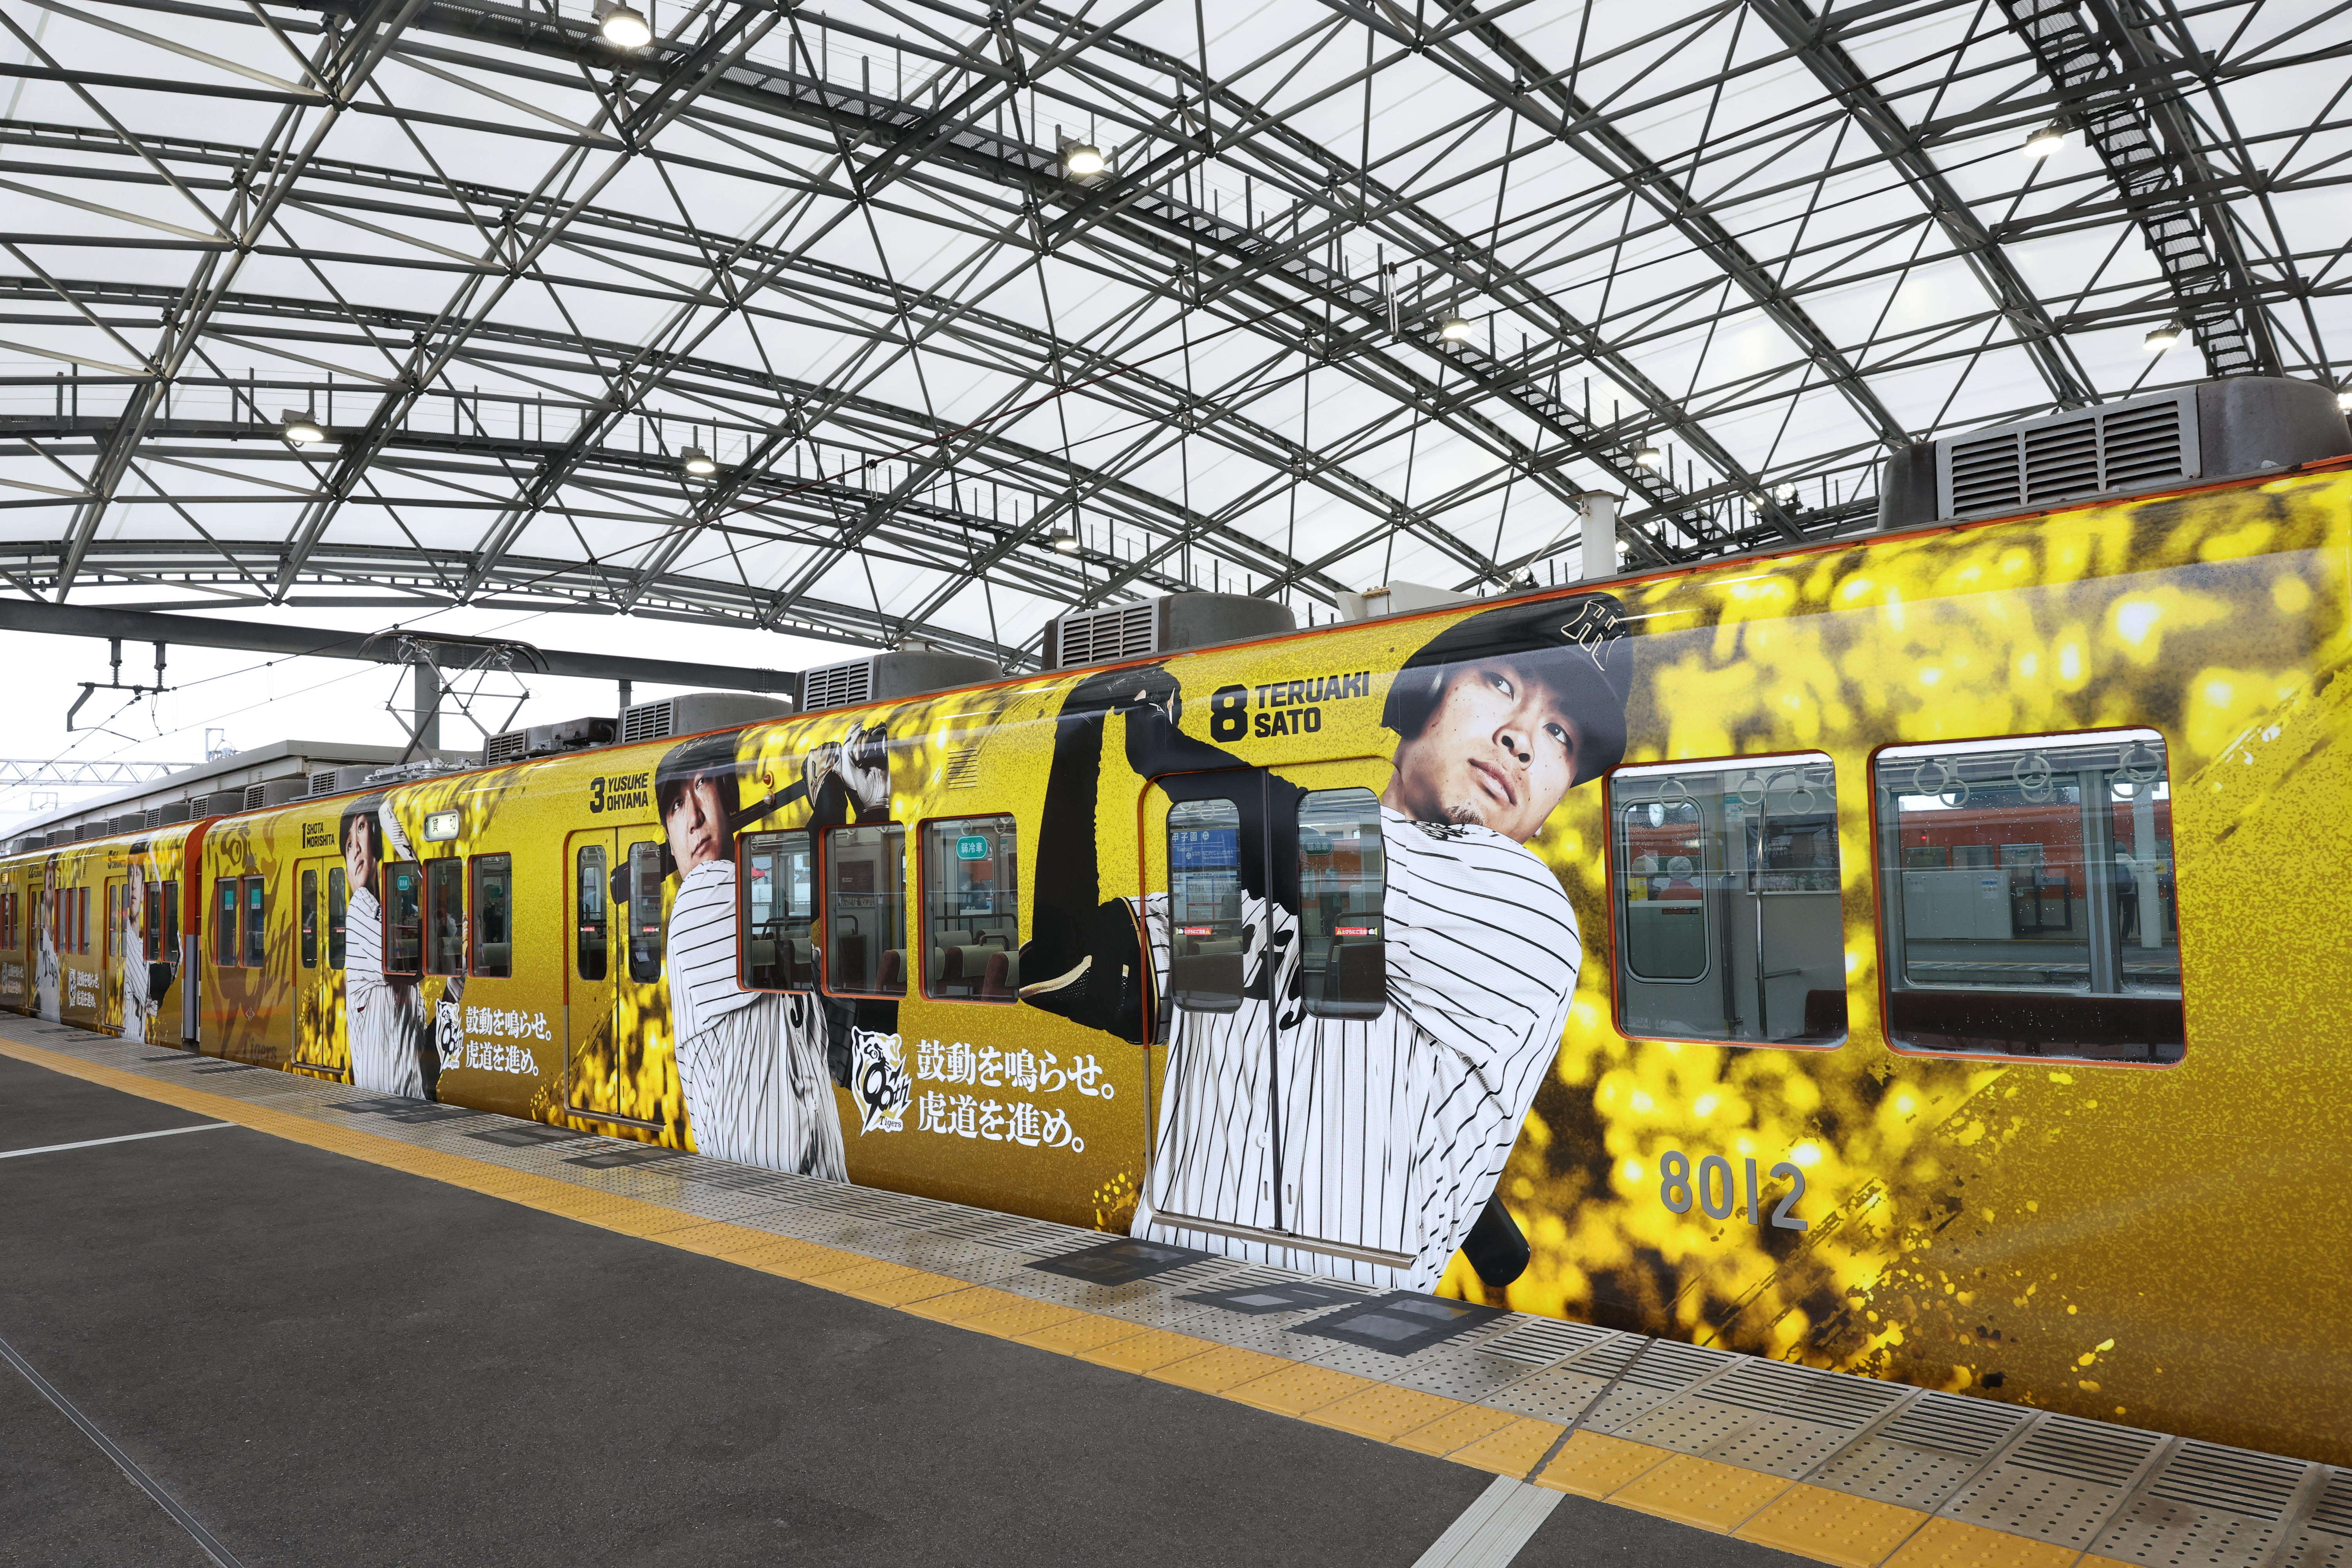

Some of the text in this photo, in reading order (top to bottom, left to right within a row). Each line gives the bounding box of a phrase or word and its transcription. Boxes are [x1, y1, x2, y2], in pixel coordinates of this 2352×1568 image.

[1255, 671, 1369, 710] TERUAKI
[1210, 684, 1248, 743] 8
[1254, 707, 1321, 738] SATO
[590, 777, 605, 813] 3
[608, 772, 650, 793] YUSUKE
[607, 791, 649, 811] OHYAMA
[302, 823, 307, 849] 1
[307, 822, 324, 835] SHOTA
[307, 834, 335, 848] MORISHITA
[1172, 831, 1198, 842] 甲子園
[961, 842, 983, 853] 弱冷車
[465, 1006, 551, 1041] 鼓動を鳴らせ。
[465, 1040, 539, 1076] 虎道を進め。
[916, 1039, 1114, 1100] 鼓動を鳴らせ。
[880, 1115, 901, 1129] Tigers
[917, 1090, 1085, 1153] 虎道を進め。
[1660, 1150, 1808, 1231] 8012
